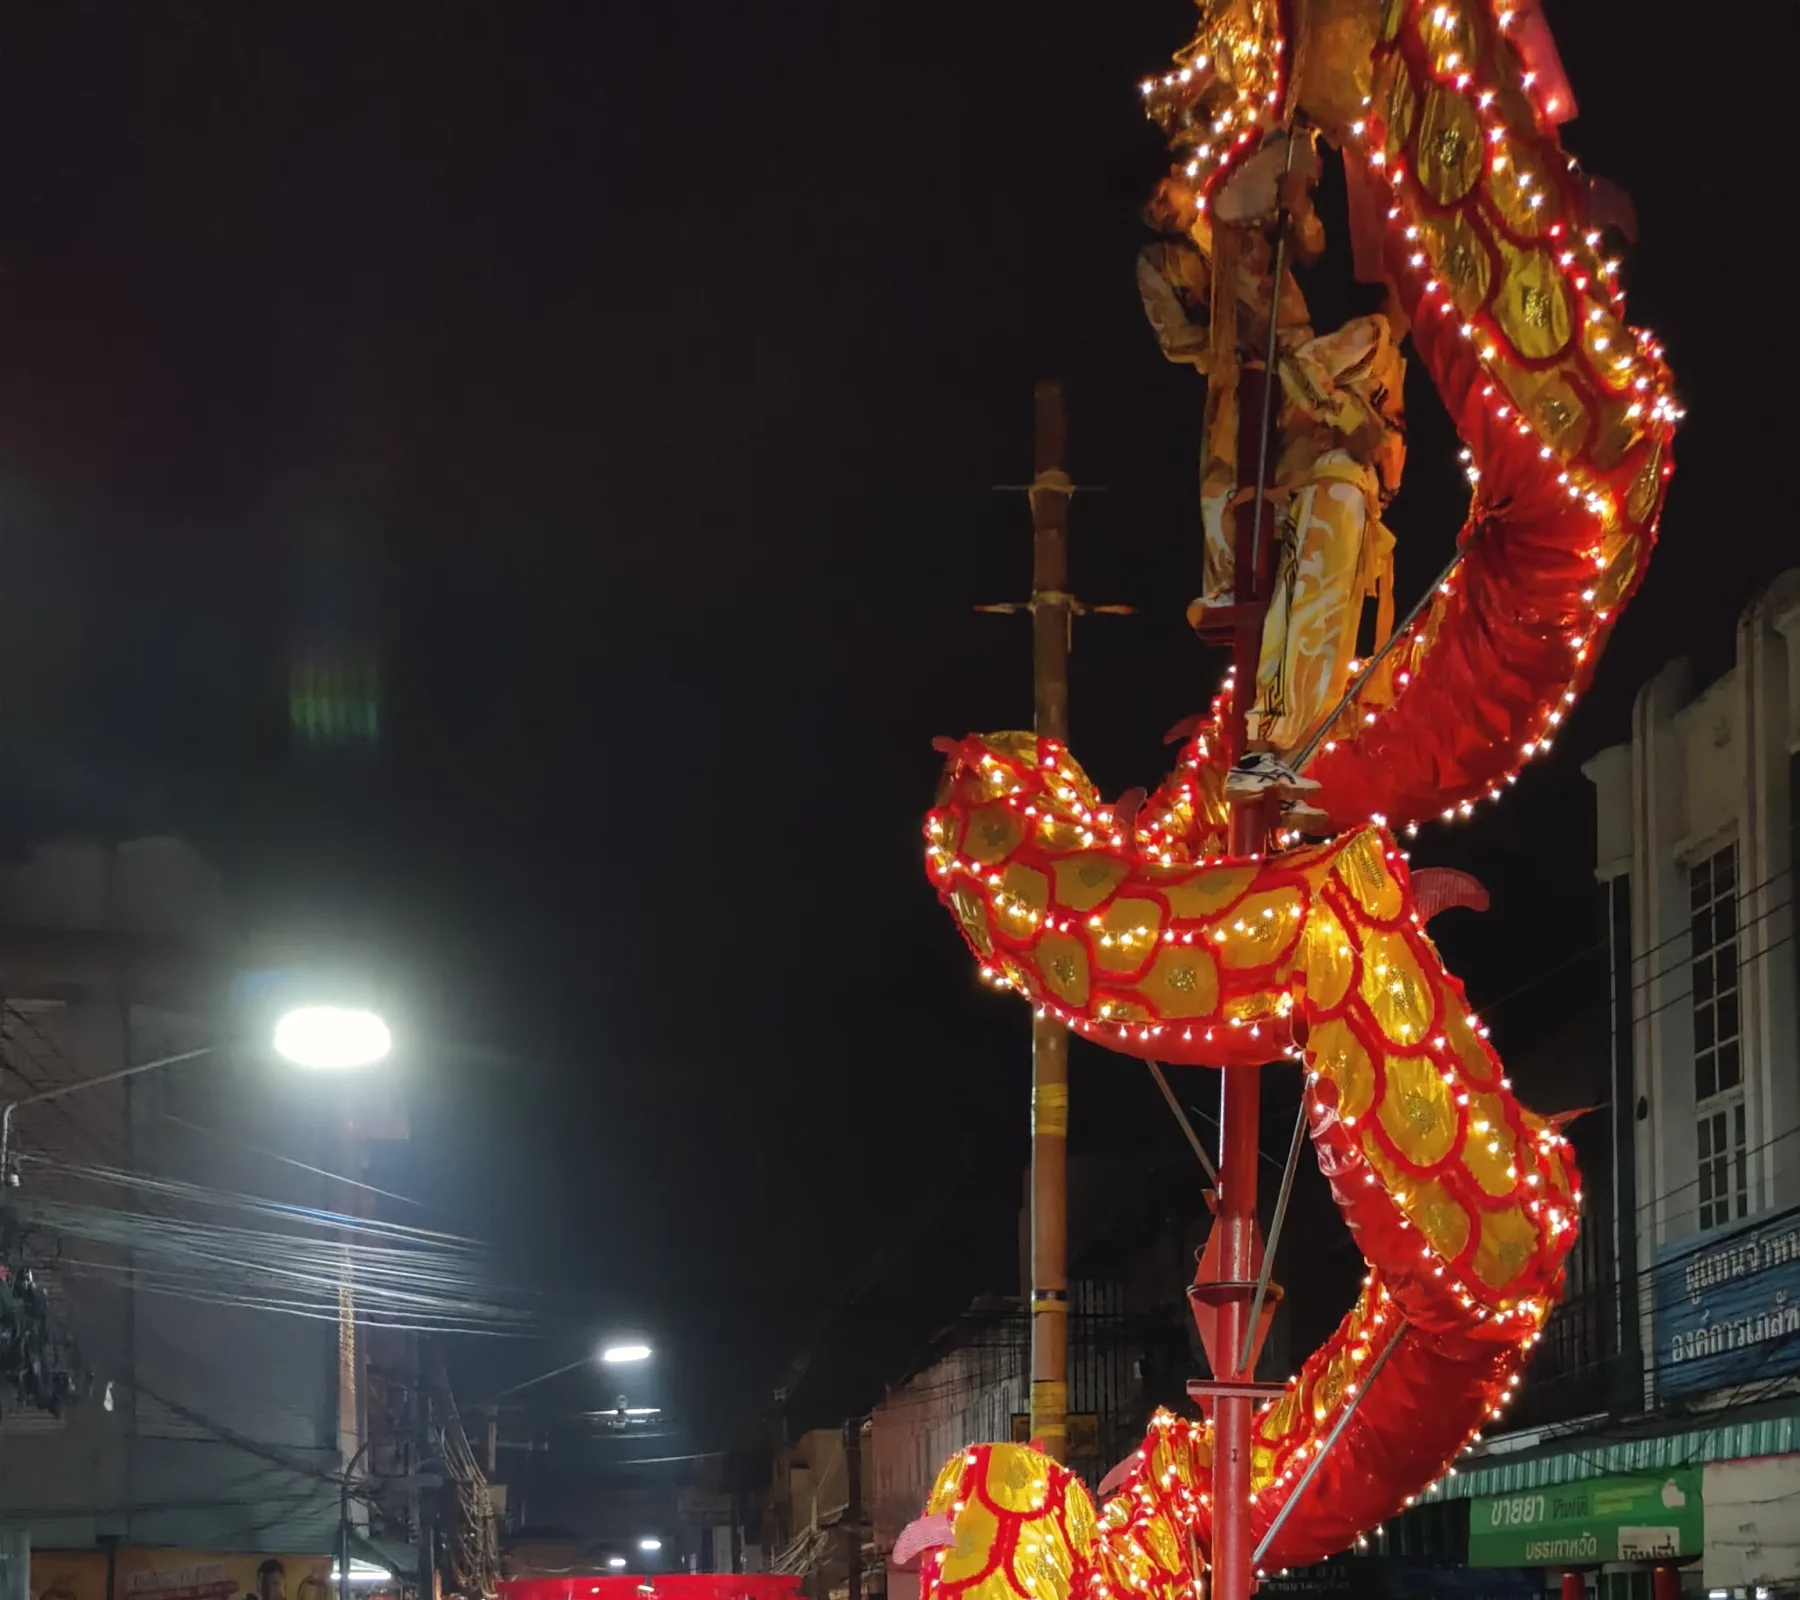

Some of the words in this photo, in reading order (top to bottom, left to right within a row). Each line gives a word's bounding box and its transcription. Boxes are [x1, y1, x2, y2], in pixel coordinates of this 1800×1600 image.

[1491, 1495, 1545, 1526] ขายยา
[1525, 1531, 1597, 1560] บรรเทาหวัด
